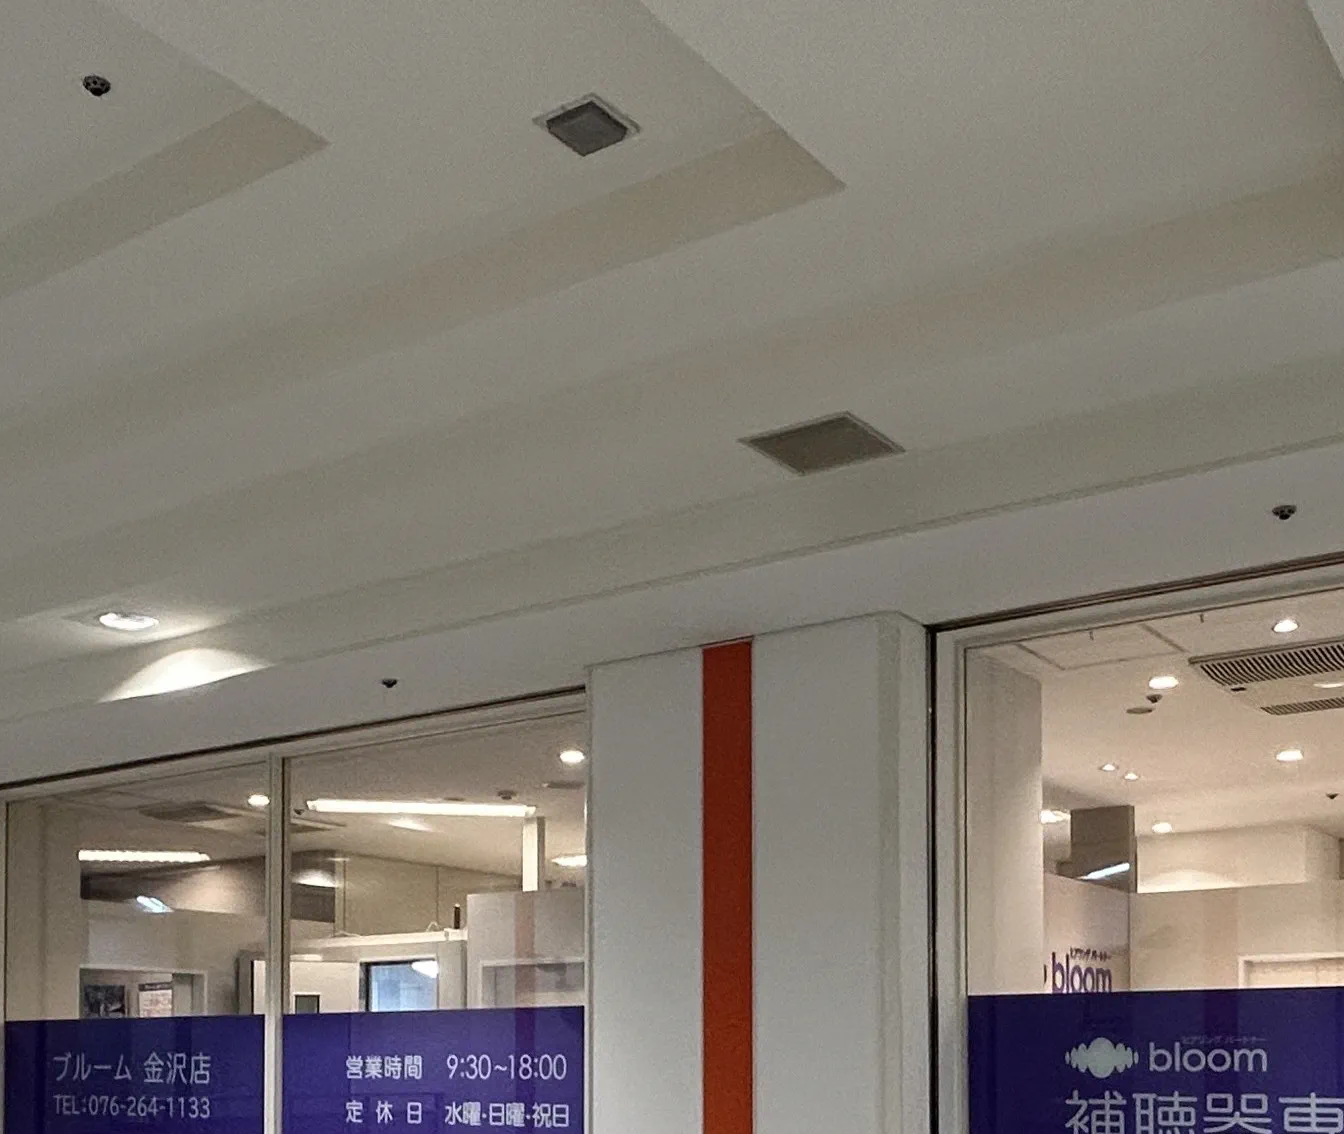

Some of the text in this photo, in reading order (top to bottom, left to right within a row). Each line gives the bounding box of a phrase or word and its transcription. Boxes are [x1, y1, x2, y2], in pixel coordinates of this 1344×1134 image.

[1052, 952, 1112, 994] bloom
[54, 1053, 212, 1085] ブルーム 金沢店
[346, 1055, 423, 1081] 営業時間
[1149, 1042, 1268, 1073] bloom
